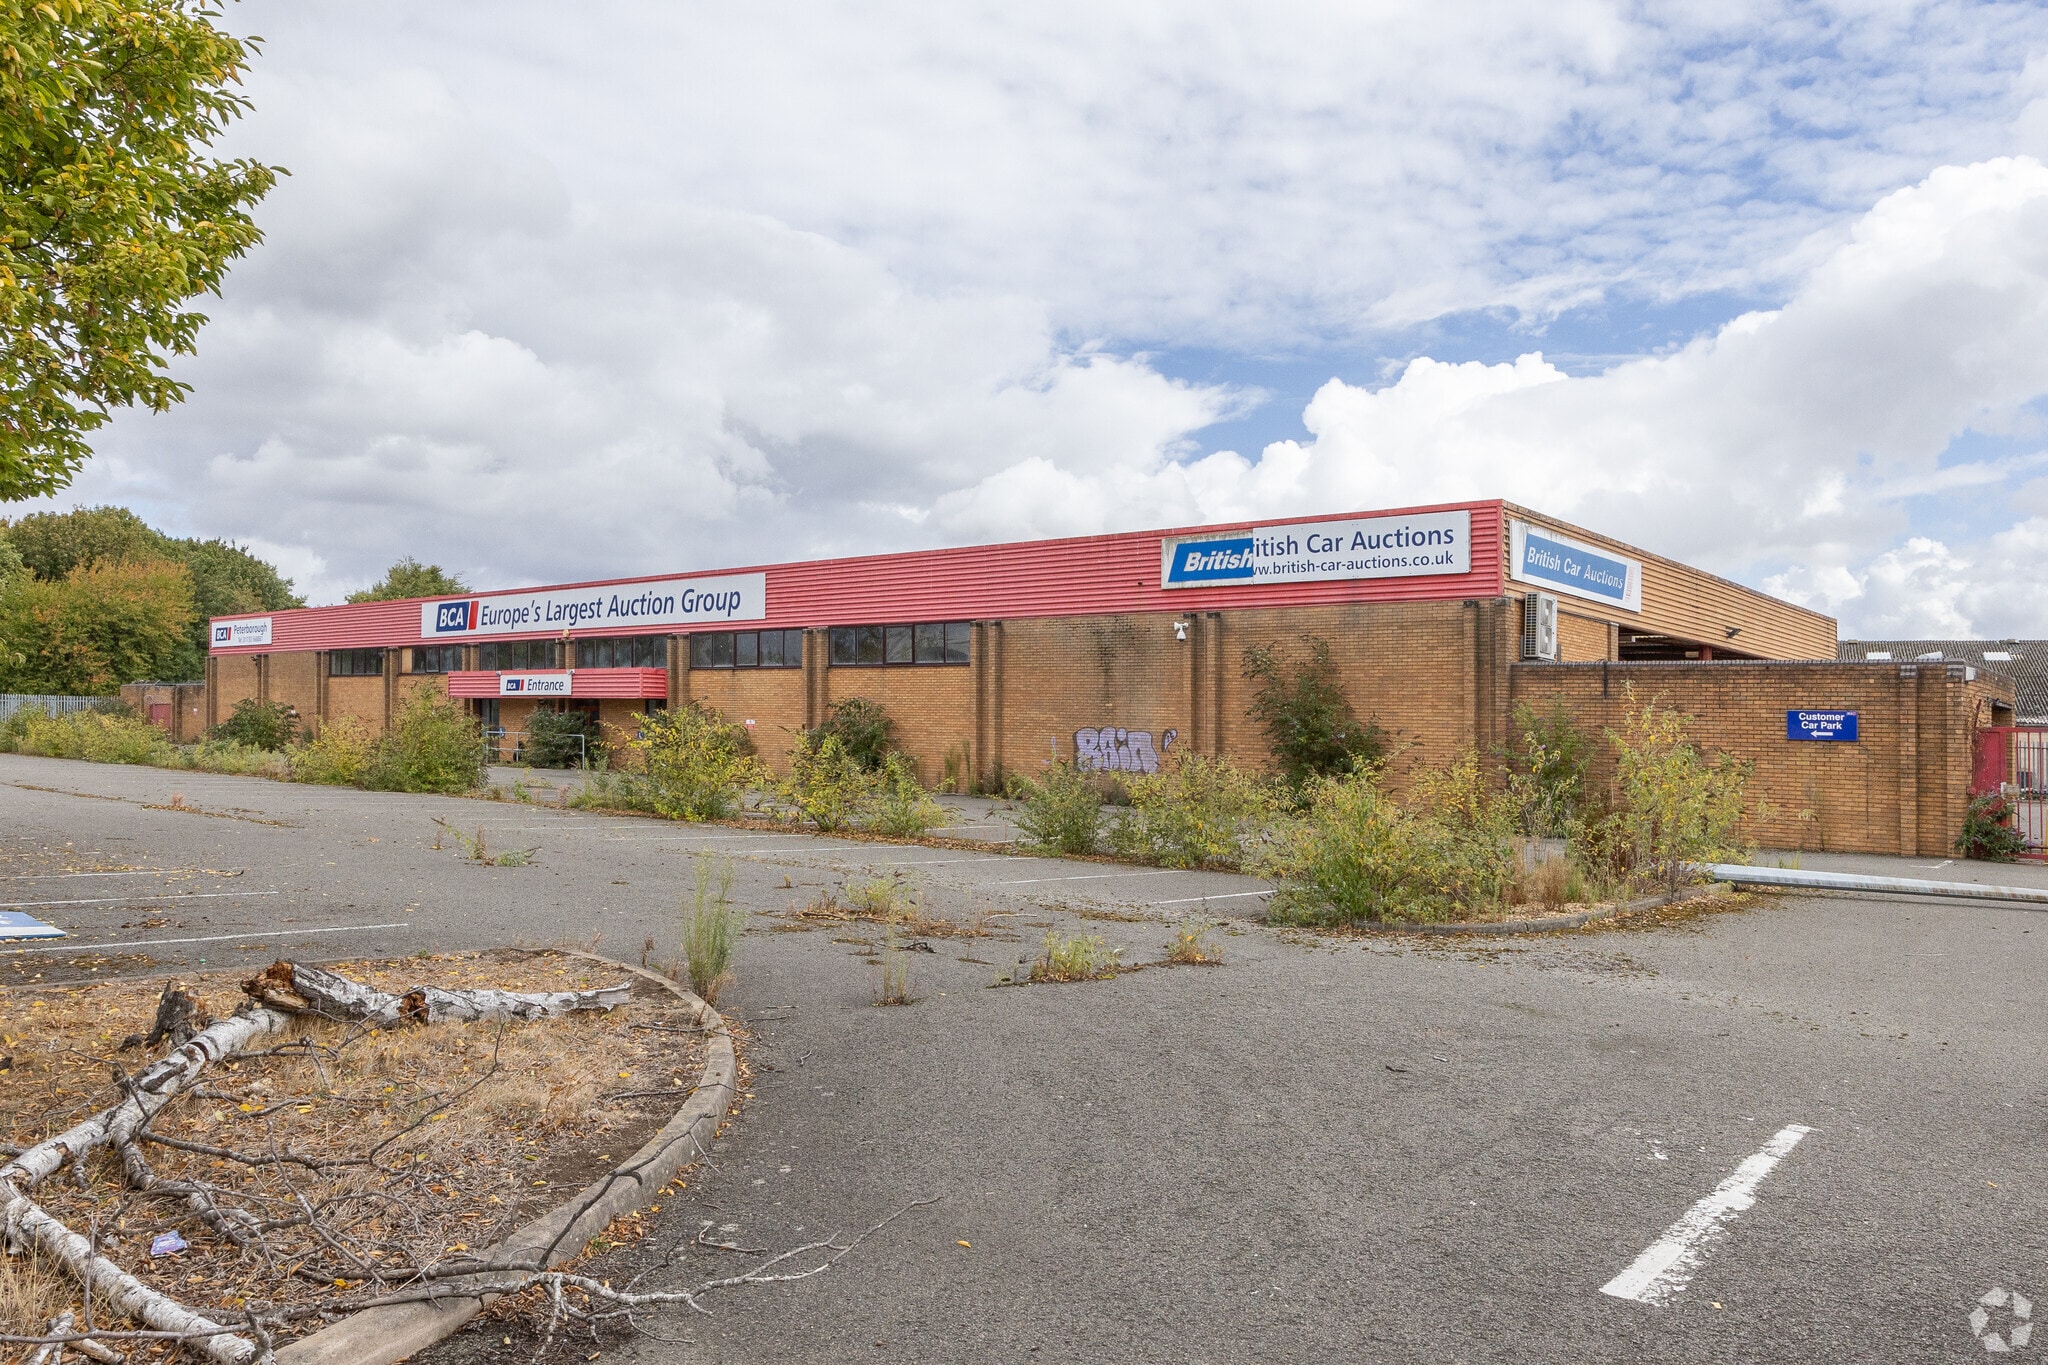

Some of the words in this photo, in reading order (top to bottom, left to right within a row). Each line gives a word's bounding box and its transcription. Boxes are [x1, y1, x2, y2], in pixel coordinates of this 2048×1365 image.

[1253, 535, 1299, 558] itish
[1307, 533, 1344, 553] Car
[1350, 526, 1454, 551] Auctions
[1184, 548, 1253, 573] British
[1527, 546, 1561, 572] British
[1563, 557, 1581, 577] Car
[1584, 565, 1623, 589] Auctions
[546, 597, 603, 626] Largest
[607, 590, 675, 618] Auction
[681, 588, 741, 617] Group
[439, 607, 464, 627] BCA
[216, 629, 227, 640] BCA
[233, 622, 268, 635] Peterborough
[507, 682, 517, 690] BCA
[527, 678, 564, 691] Entrance
[1798, 712, 1845, 721] Customer
[1801, 721, 1818, 729] Car
[1820, 721, 1842, 730] Park
